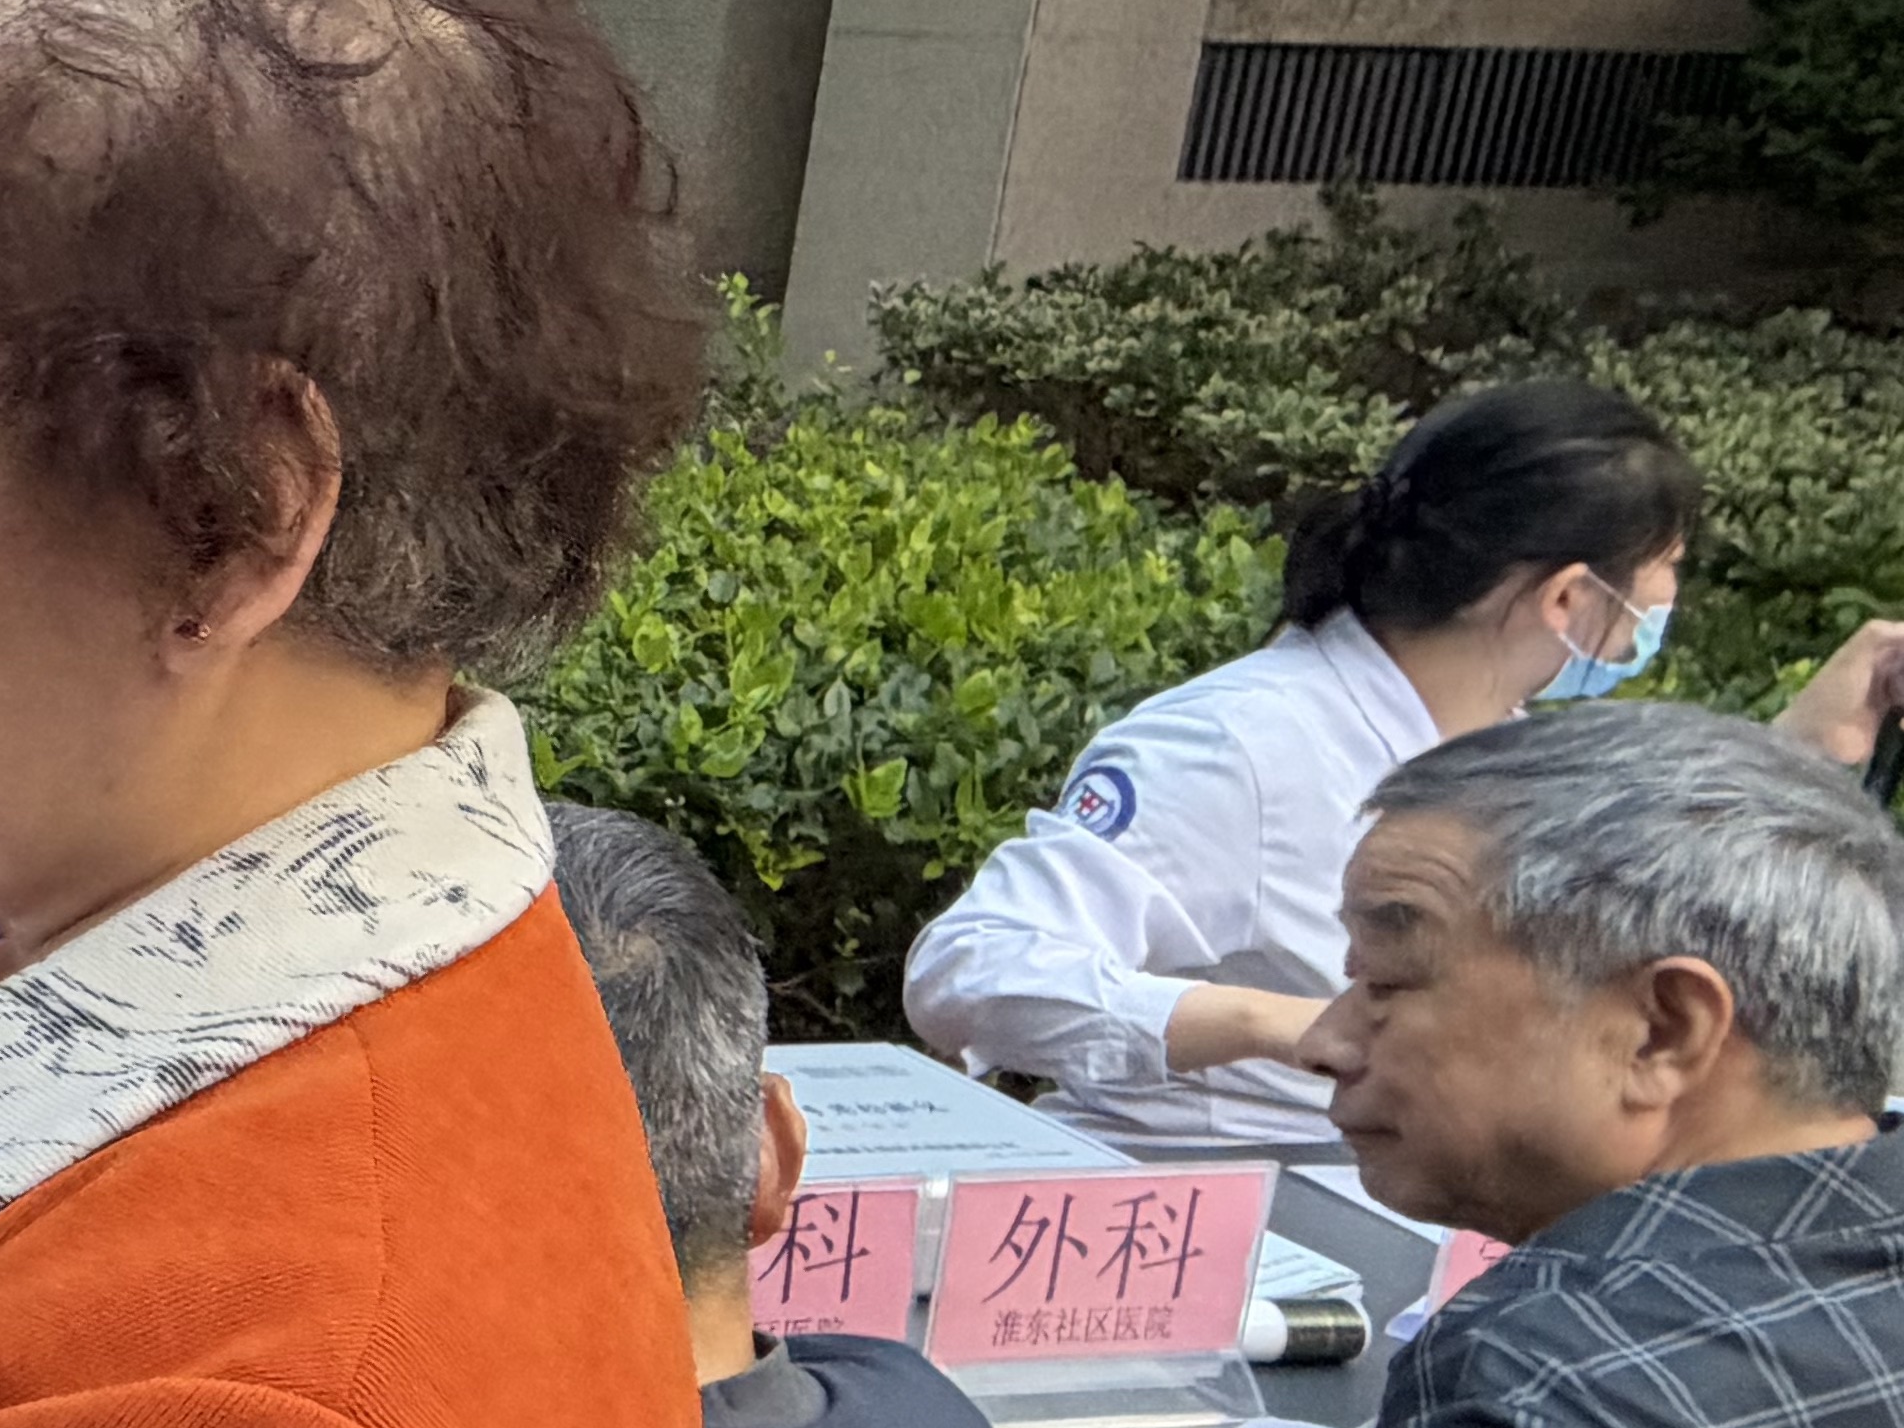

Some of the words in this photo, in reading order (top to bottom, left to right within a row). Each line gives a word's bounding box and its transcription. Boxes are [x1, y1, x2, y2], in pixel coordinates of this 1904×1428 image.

[983, 1184, 1204, 1304] 外科
[991, 1303, 1174, 1347] 淮东社区医院
